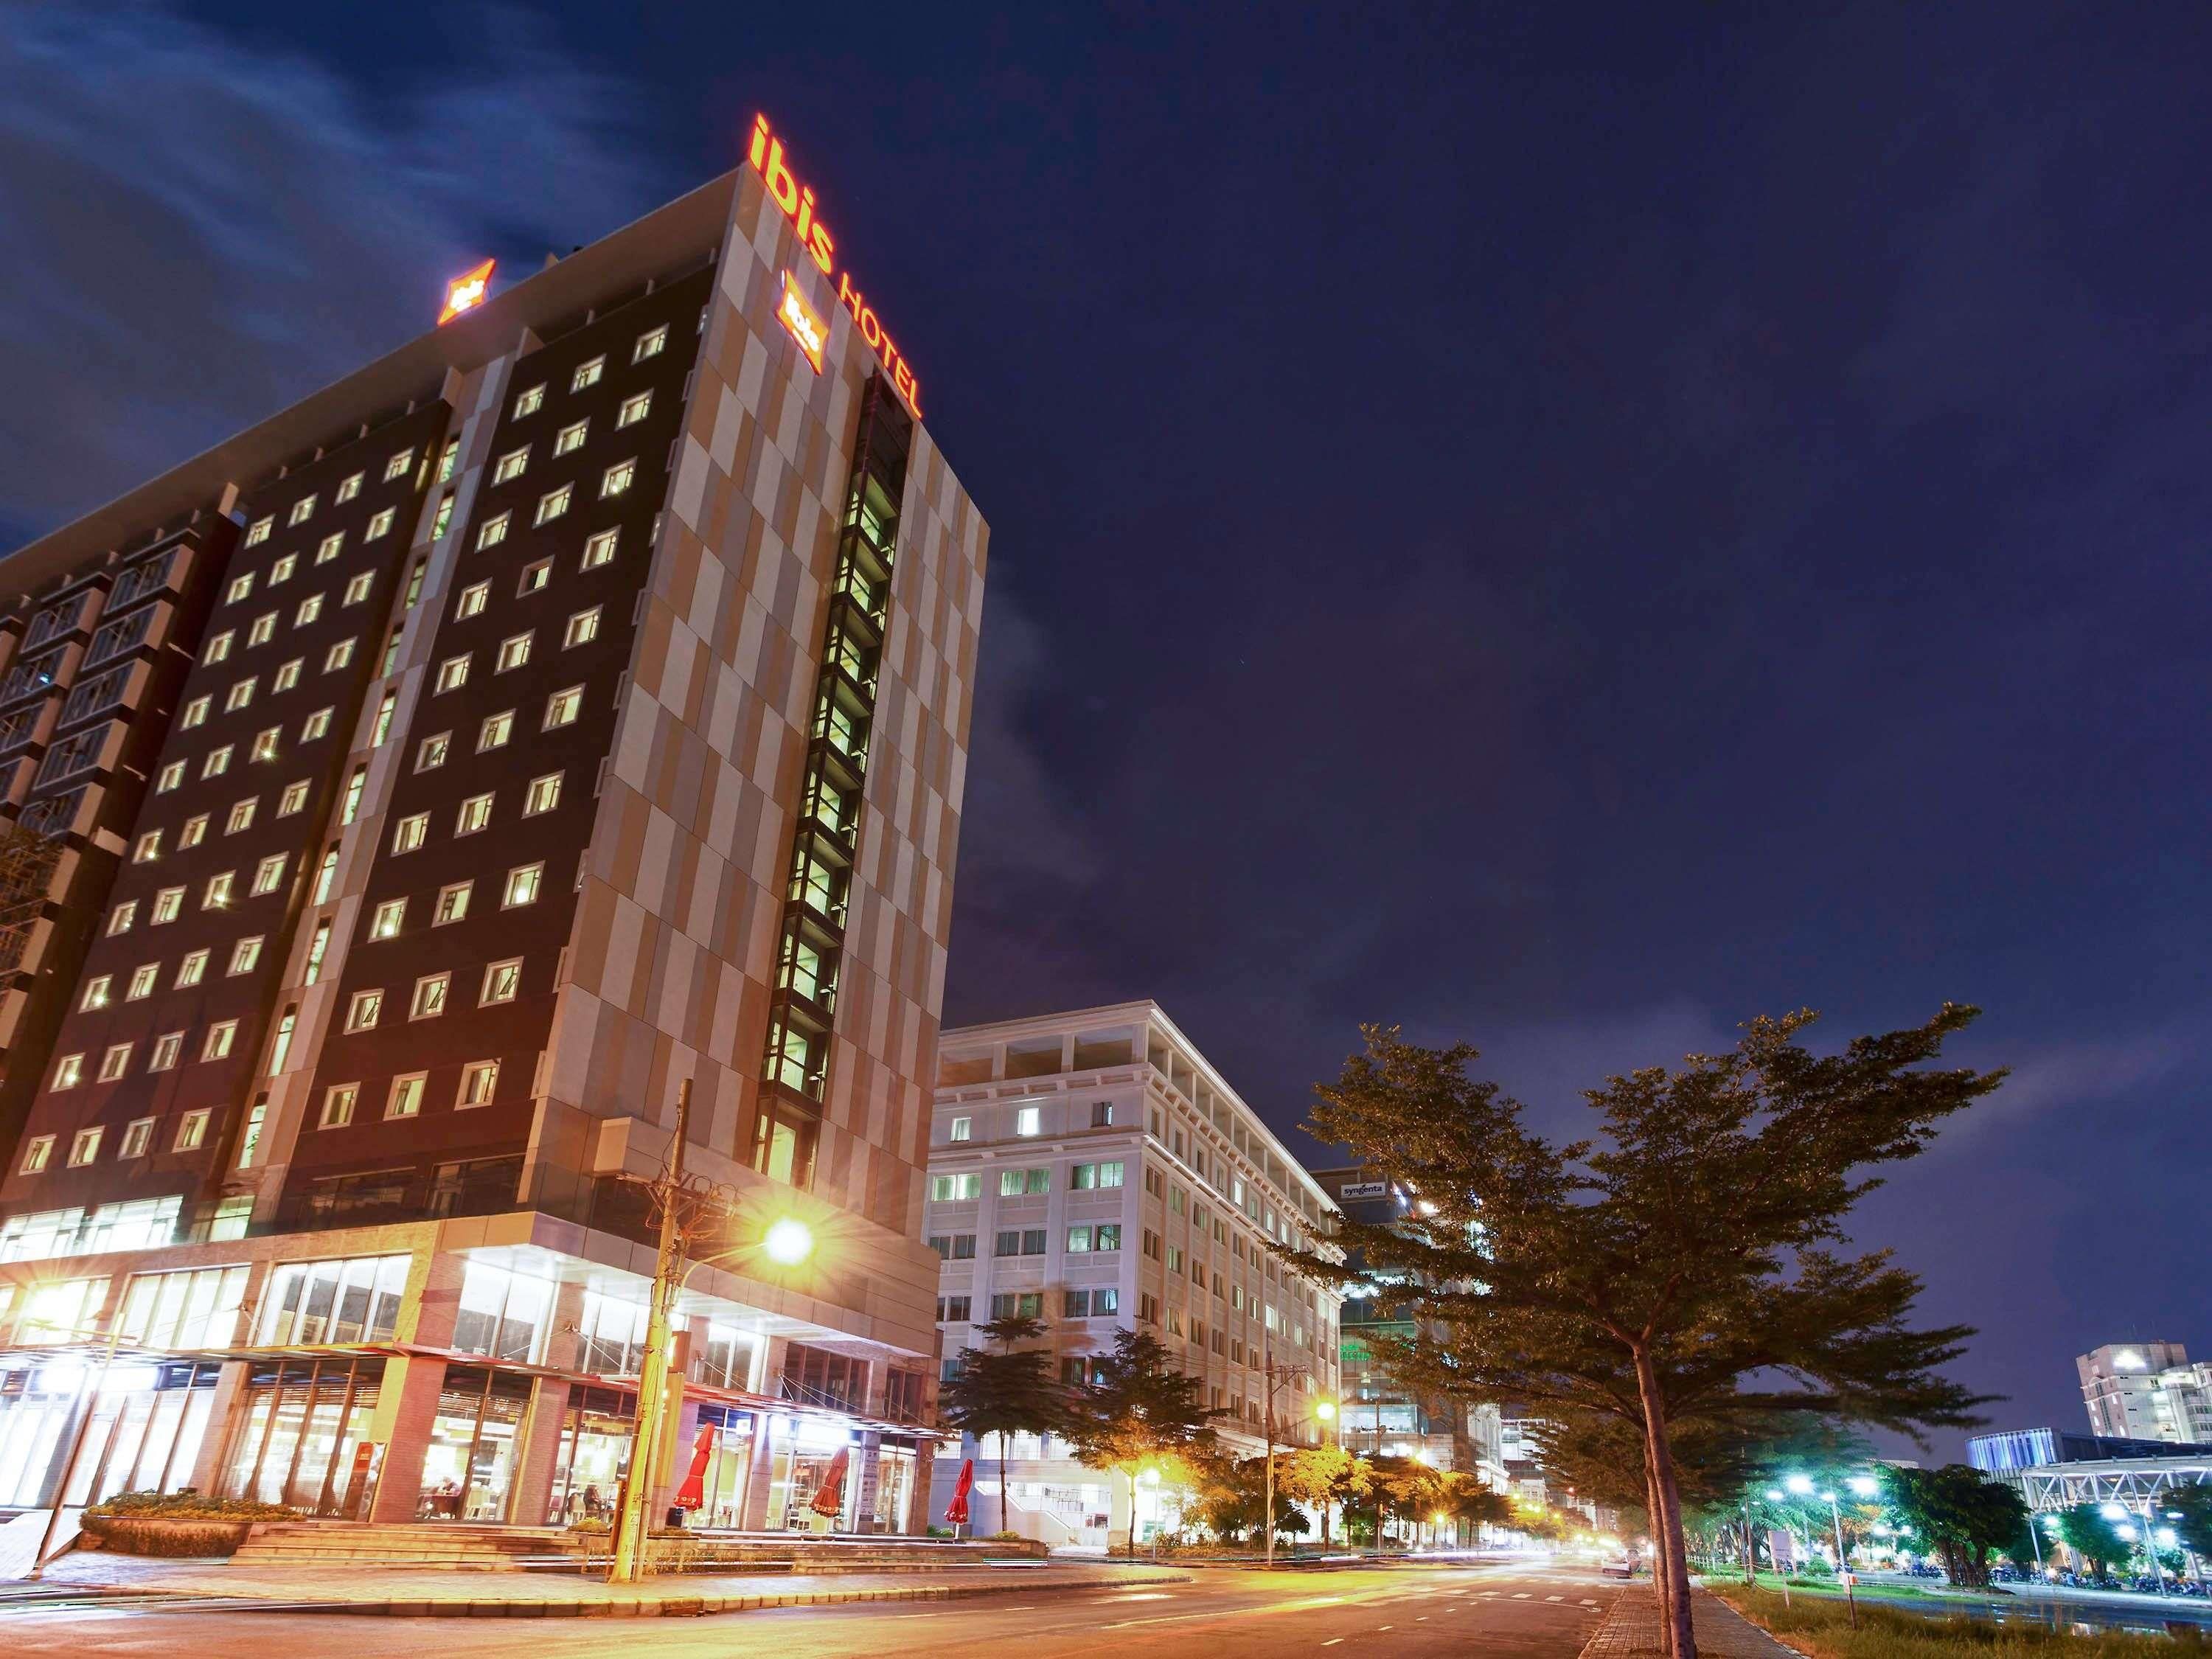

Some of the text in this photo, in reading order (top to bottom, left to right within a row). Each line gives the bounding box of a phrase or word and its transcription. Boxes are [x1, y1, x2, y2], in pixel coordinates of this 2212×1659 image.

[749, 113, 922, 418] ibis HOTEL
[1344, 1185, 1382, 1196] syngenta
